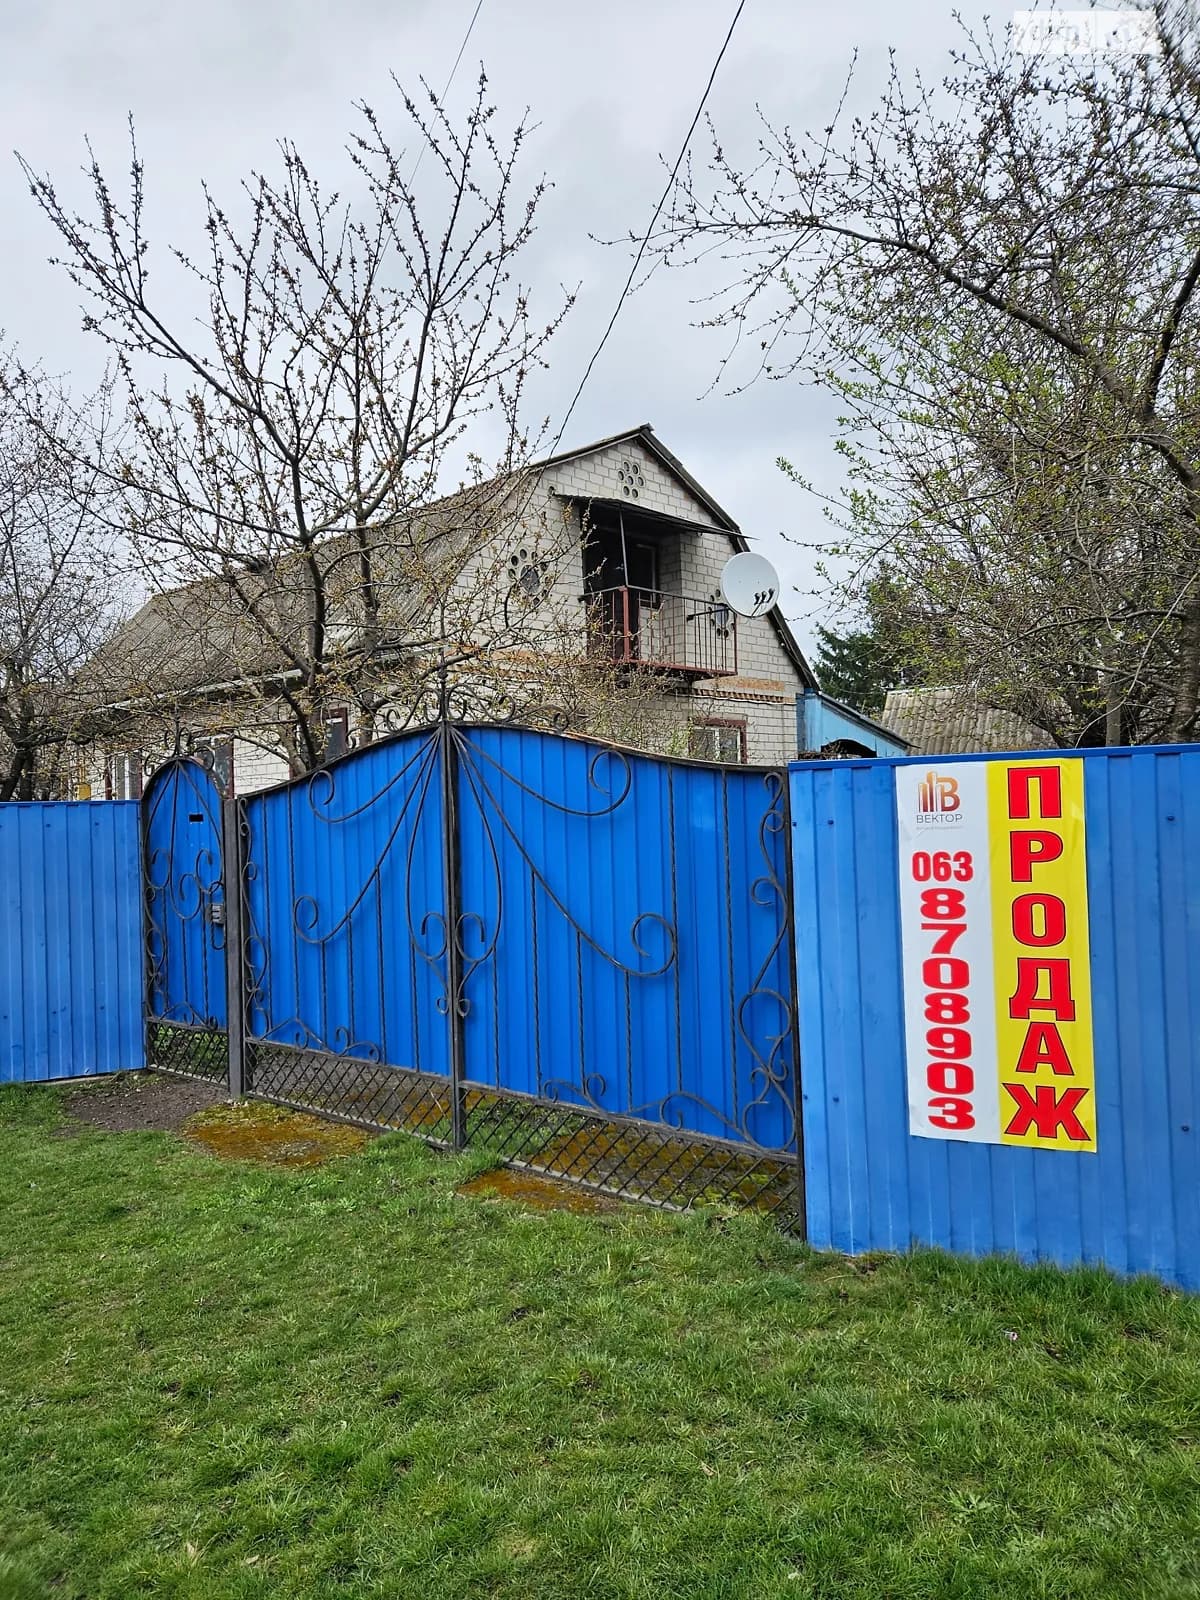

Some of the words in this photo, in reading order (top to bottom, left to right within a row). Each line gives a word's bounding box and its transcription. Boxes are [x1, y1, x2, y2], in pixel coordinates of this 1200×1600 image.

[912, 851, 974, 882] 063
[916, 813, 963, 823] ВЕКТОР
[920, 887, 975, 1130] 8708903
[1002, 766, 1091, 1141] ПРОДАЖ
